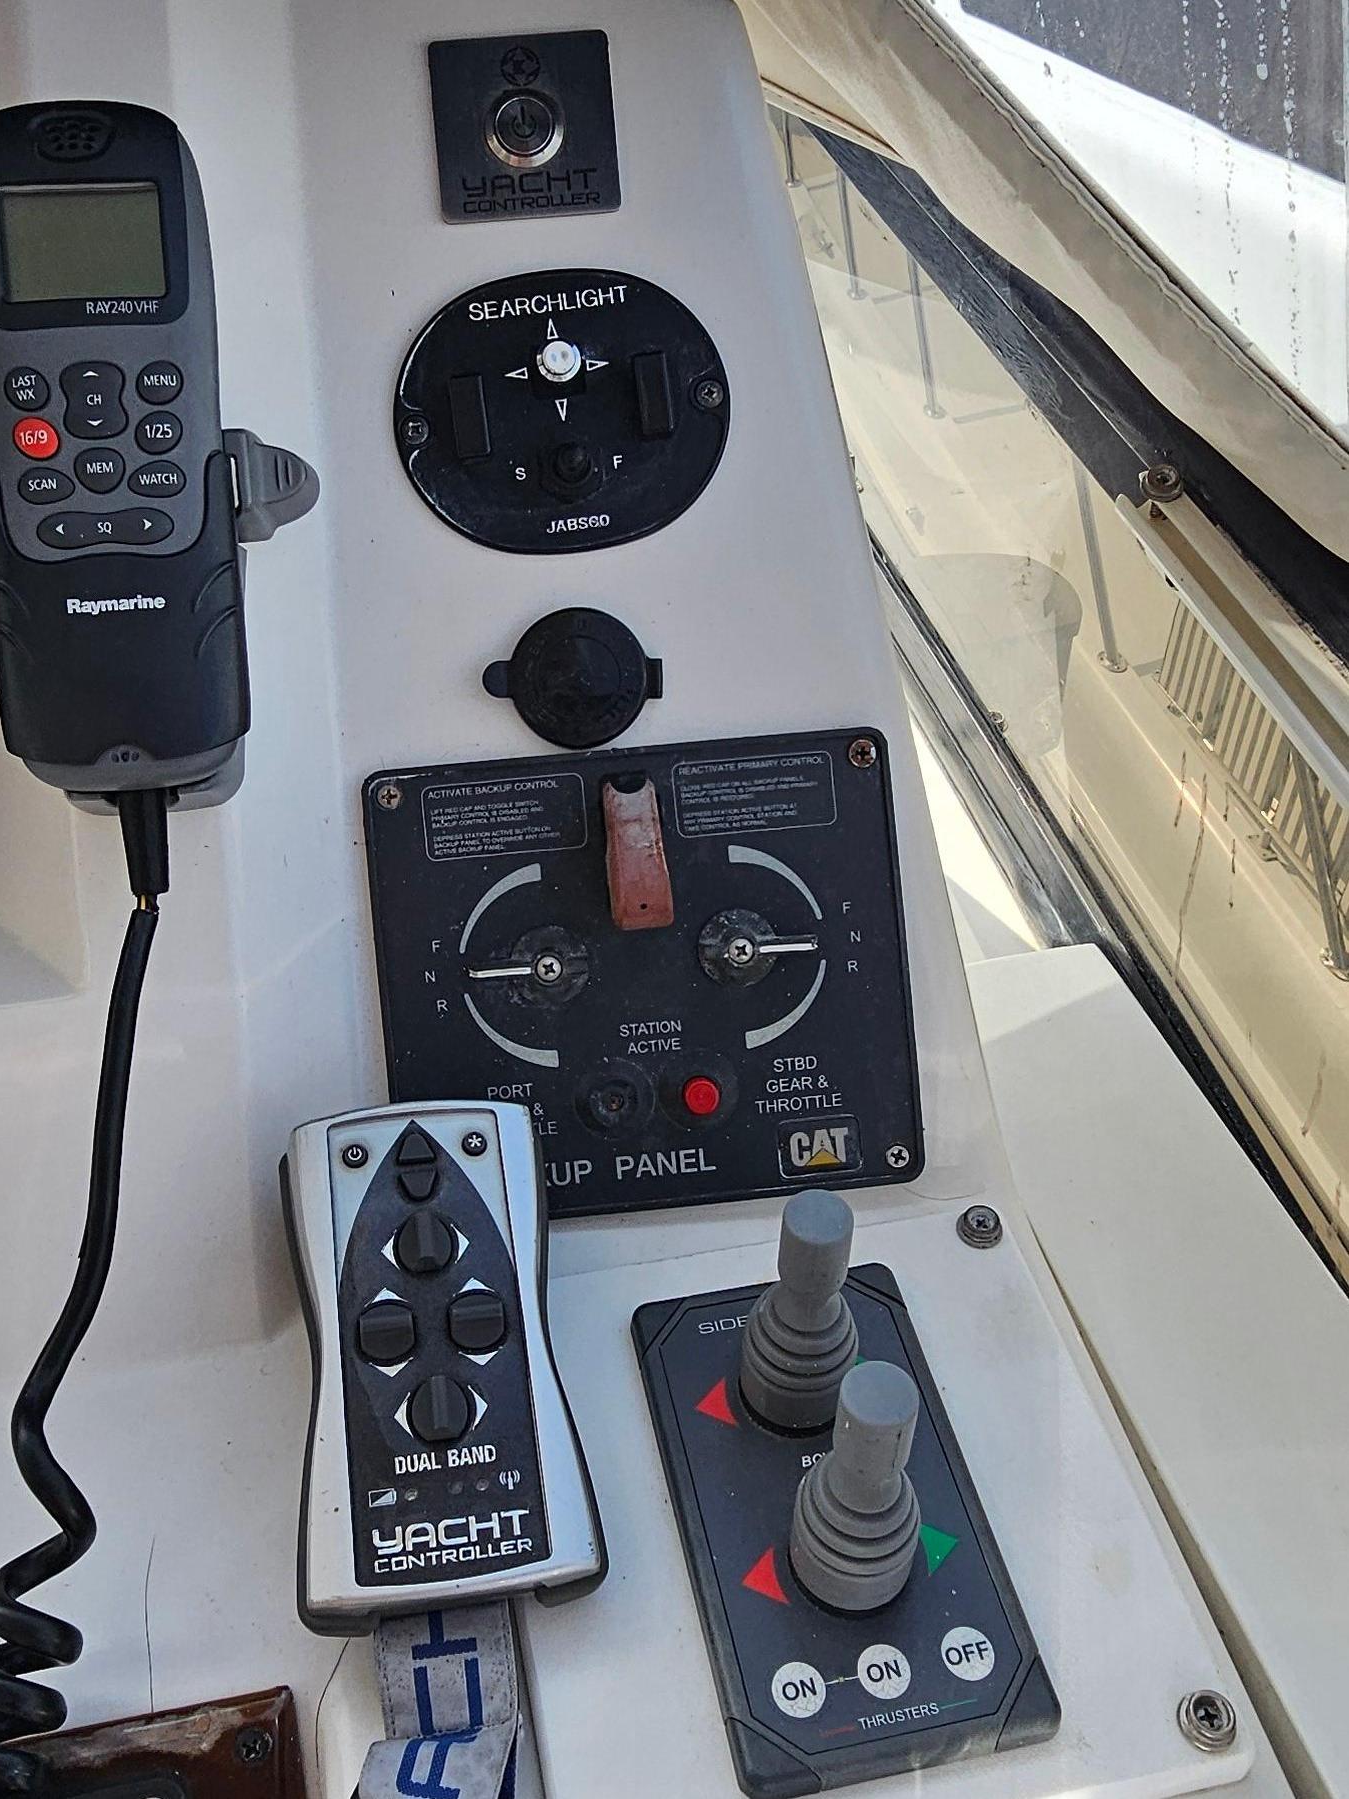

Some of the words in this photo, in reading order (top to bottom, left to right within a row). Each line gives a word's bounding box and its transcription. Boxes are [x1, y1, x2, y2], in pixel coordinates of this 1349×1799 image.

[462, 167, 597, 196] YACHT
[463, 191, 600, 213] CONTROLLER
[469, 285, 628, 321] SEARCHLIGHT
[12, 375, 36, 388] LAST
[144, 374, 177, 387] MENU
[17, 388, 36, 401] WX
[86, 393, 102, 406] CH
[19, 429, 48, 446] 16/9
[144, 423, 173, 440] 1/25
[86, 461, 114, 475] MEM
[613, 456, 623, 469] F
[139, 472, 178, 487] WATCH
[516, 467, 526, 481] S
[28, 477, 57, 492] SCAN
[97, 521, 113, 536] SQ
[67, 594, 166, 614] Raymarine
[780, 756, 825, 767] CONTROL
[428, 787, 473, 800] ACTIVATE
[474, 783, 512, 795] BACKUP
[514, 780, 559, 791] CONTROL
[843, 902, 852, 915] F
[851, 931, 861, 943] N
[432, 940, 441, 952] F
[848, 960, 858, 973] R
[425, 971, 436, 983] N
[436, 1000, 447, 1012] R
[619, 1020, 682, 1037] STATION
[628, 1037, 681, 1054] ACTIVE
[773, 1055, 817, 1072] STBD
[487, 1083, 533, 1100] PORT
[766, 1077, 812, 1093] GEAR
[818, 1075, 829, 1088] &
[755, 1093, 843, 1114] THROTTLE
[789, 1127, 849, 1167] CAT
[615, 1148, 717, 1180] PANEL
[395, 1451, 442, 1475] DUAL
[447, 1444, 497, 1467] BAND
[373, 1508, 530, 1555] YACHT
[374, 1537, 532, 1573] CONTROLLER
[945, 1640, 989, 1666] OFF
[866, 1659, 902, 1683] ON
[782, 1677, 817, 1701] ON
[857, 1702, 940, 1730] THRUSTERS
